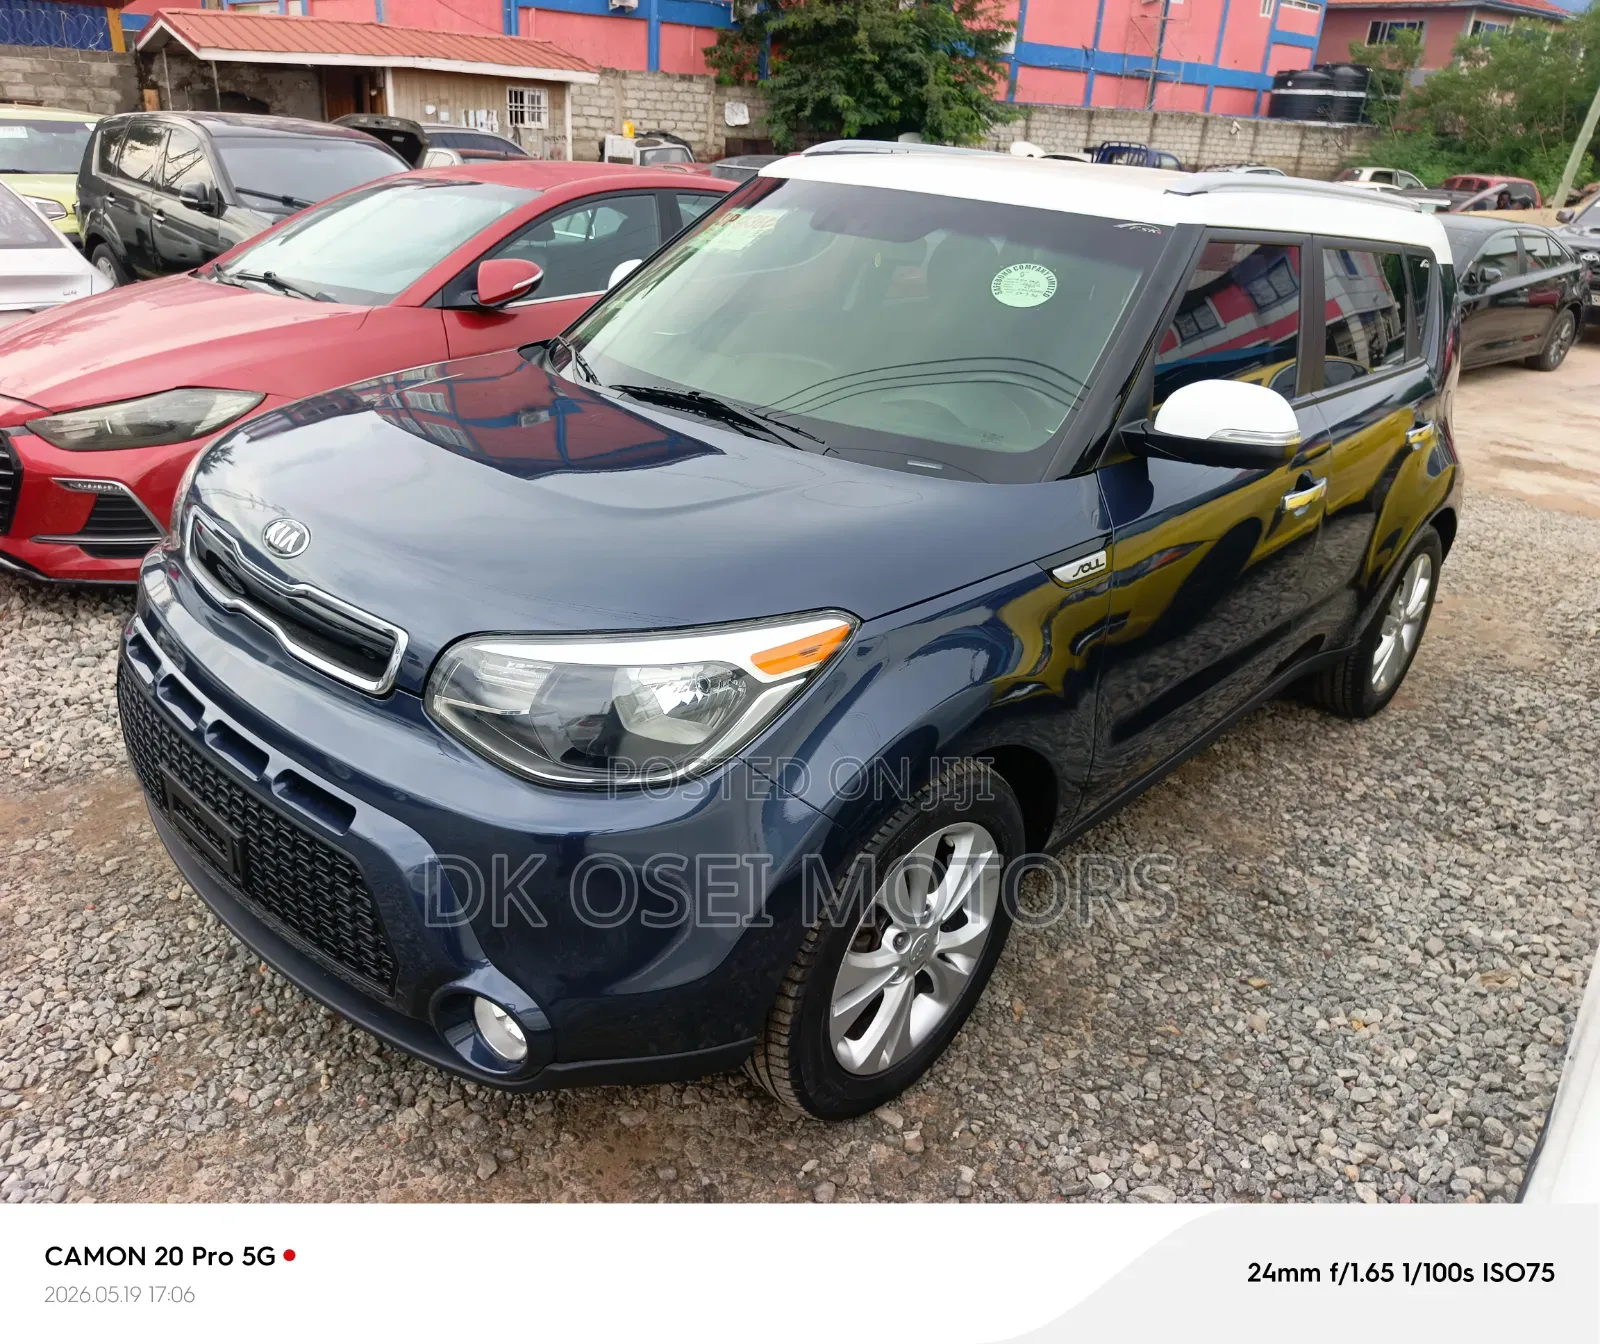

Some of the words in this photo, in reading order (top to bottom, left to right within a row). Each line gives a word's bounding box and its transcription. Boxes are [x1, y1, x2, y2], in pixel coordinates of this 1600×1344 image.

[993, 268, 1013, 296] SAFEBOND
[1013, 264, 1049, 276] COMPANY
[265, 521, 301, 553] KIA
[1072, 558, 1105, 578] SOUL
